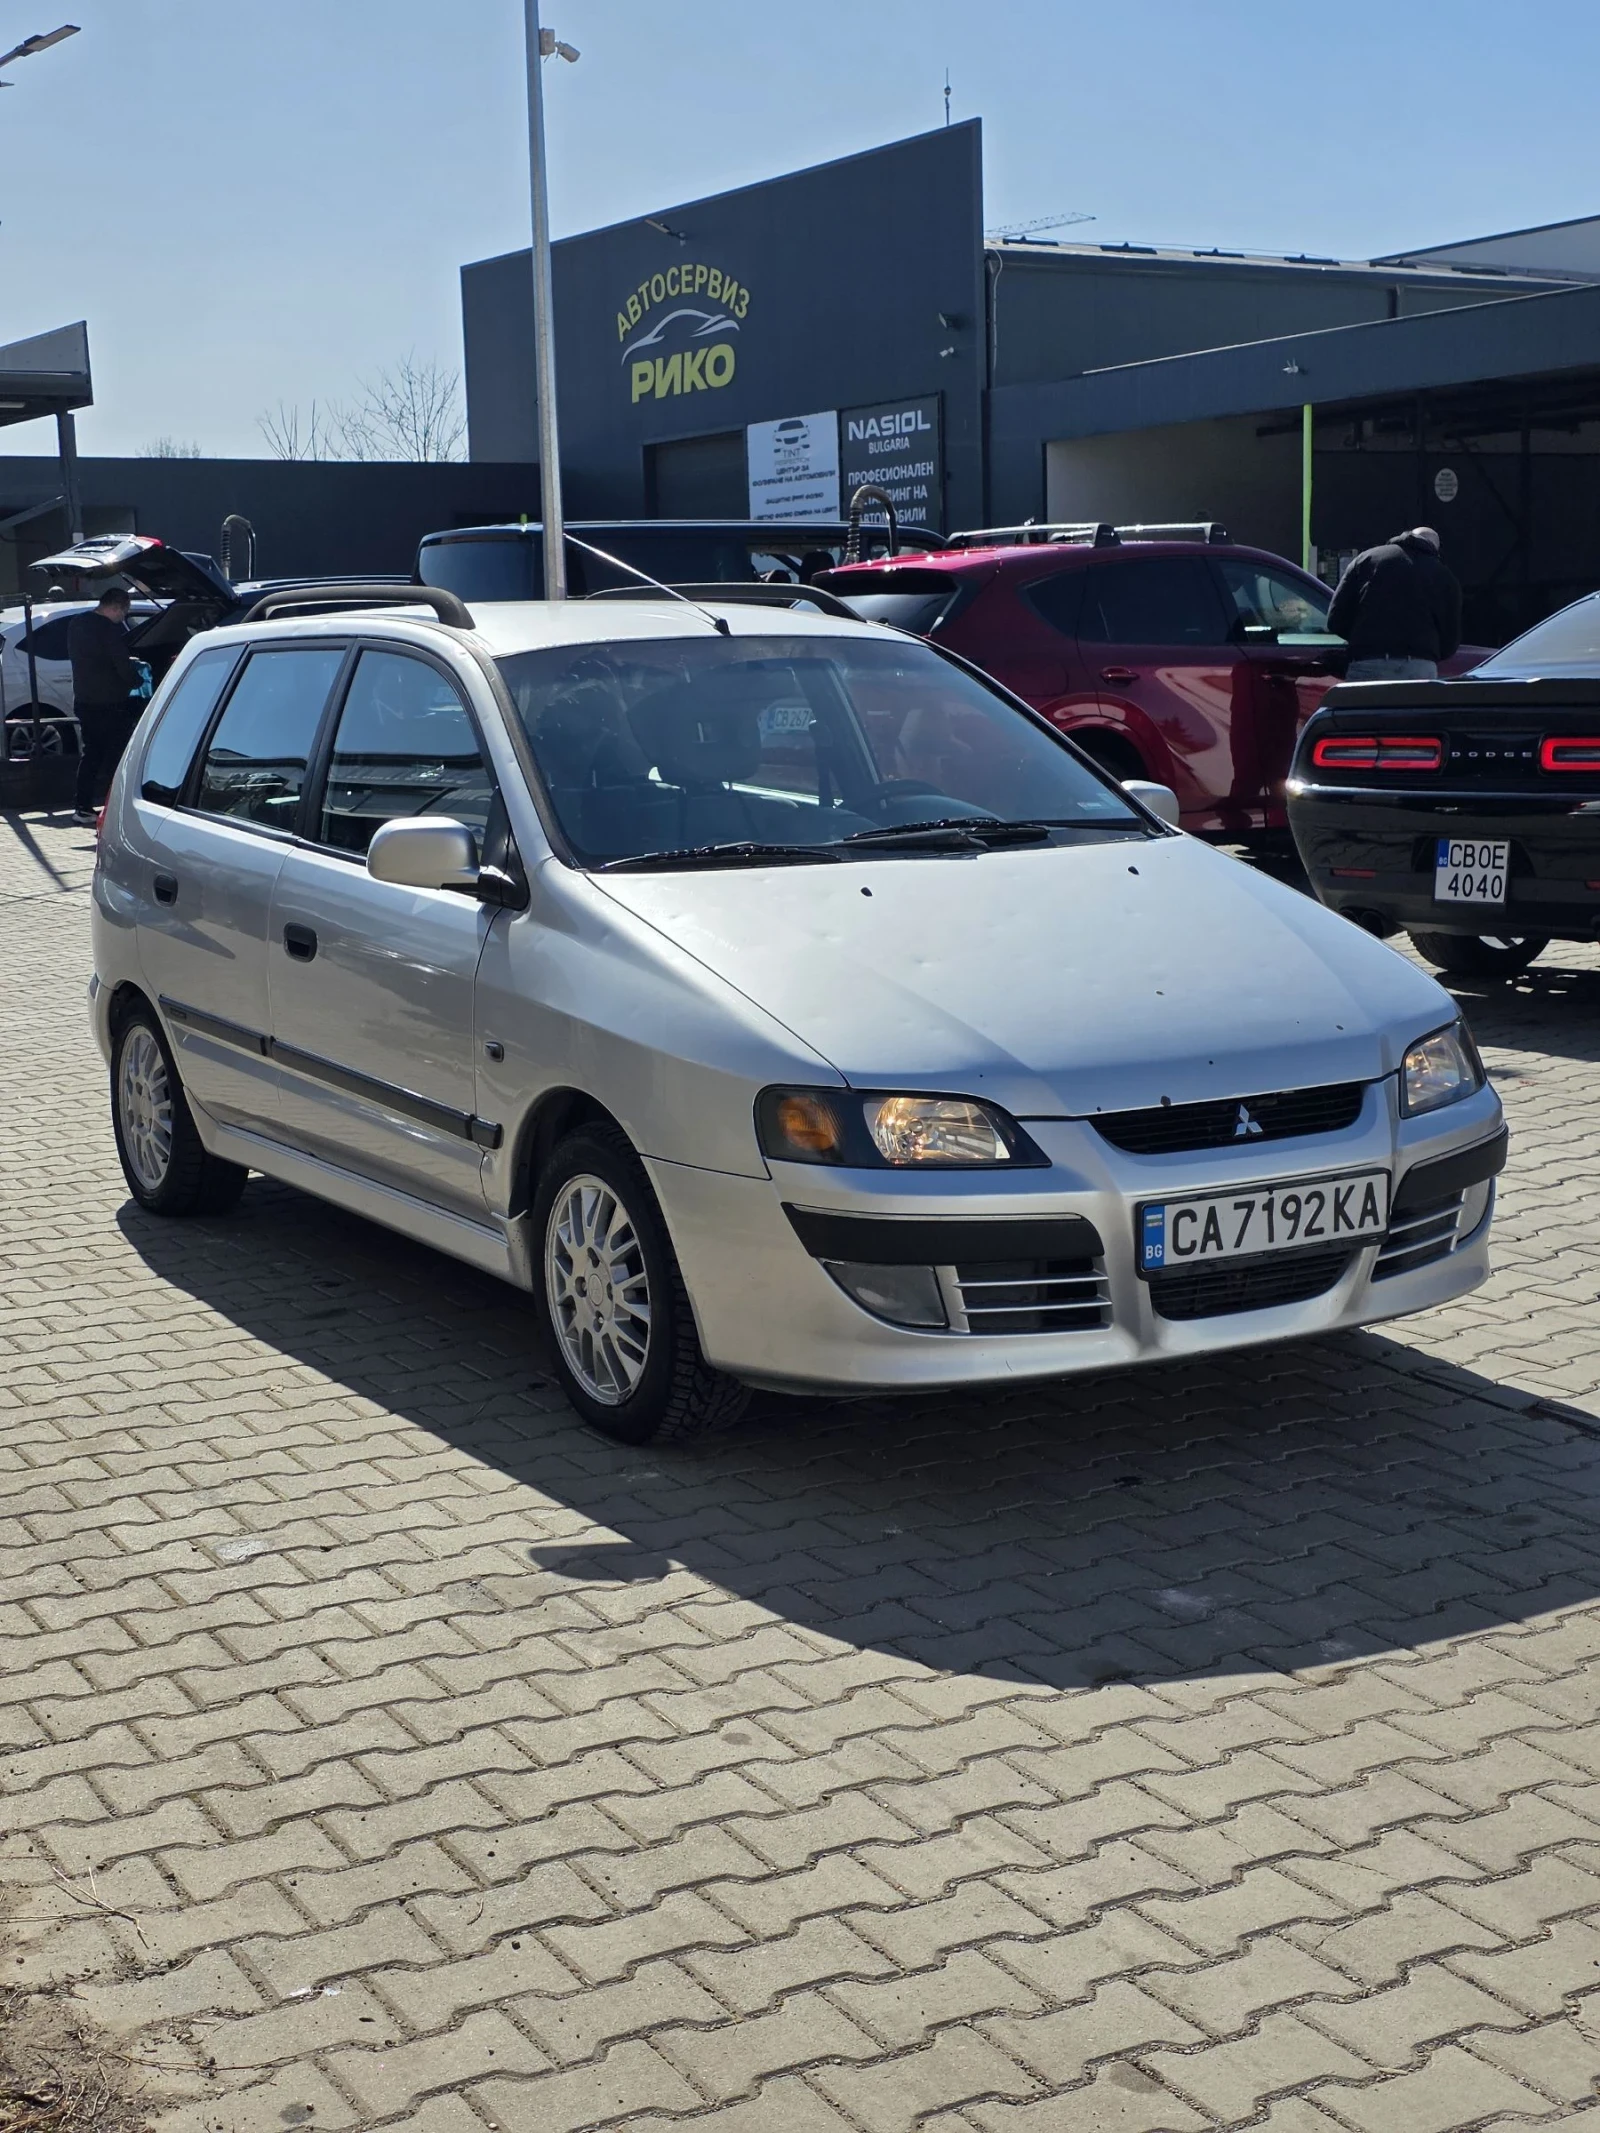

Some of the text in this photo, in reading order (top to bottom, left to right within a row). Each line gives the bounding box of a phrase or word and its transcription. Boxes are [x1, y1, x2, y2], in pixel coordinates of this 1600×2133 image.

[616, 264, 750, 342] АВТОСЕРВИЗ
[631, 344, 735, 403] РИКО
[848, 410, 931, 441] NASIOL
[868, 437, 910, 454] BULGARIA
[848, 461, 934, 486] ПРОФЕСИОНАЛЕН
[913, 484, 928, 499] НА
[1448, 873, 1502, 897] 4040
[1145, 1245, 1163, 1259] BG
